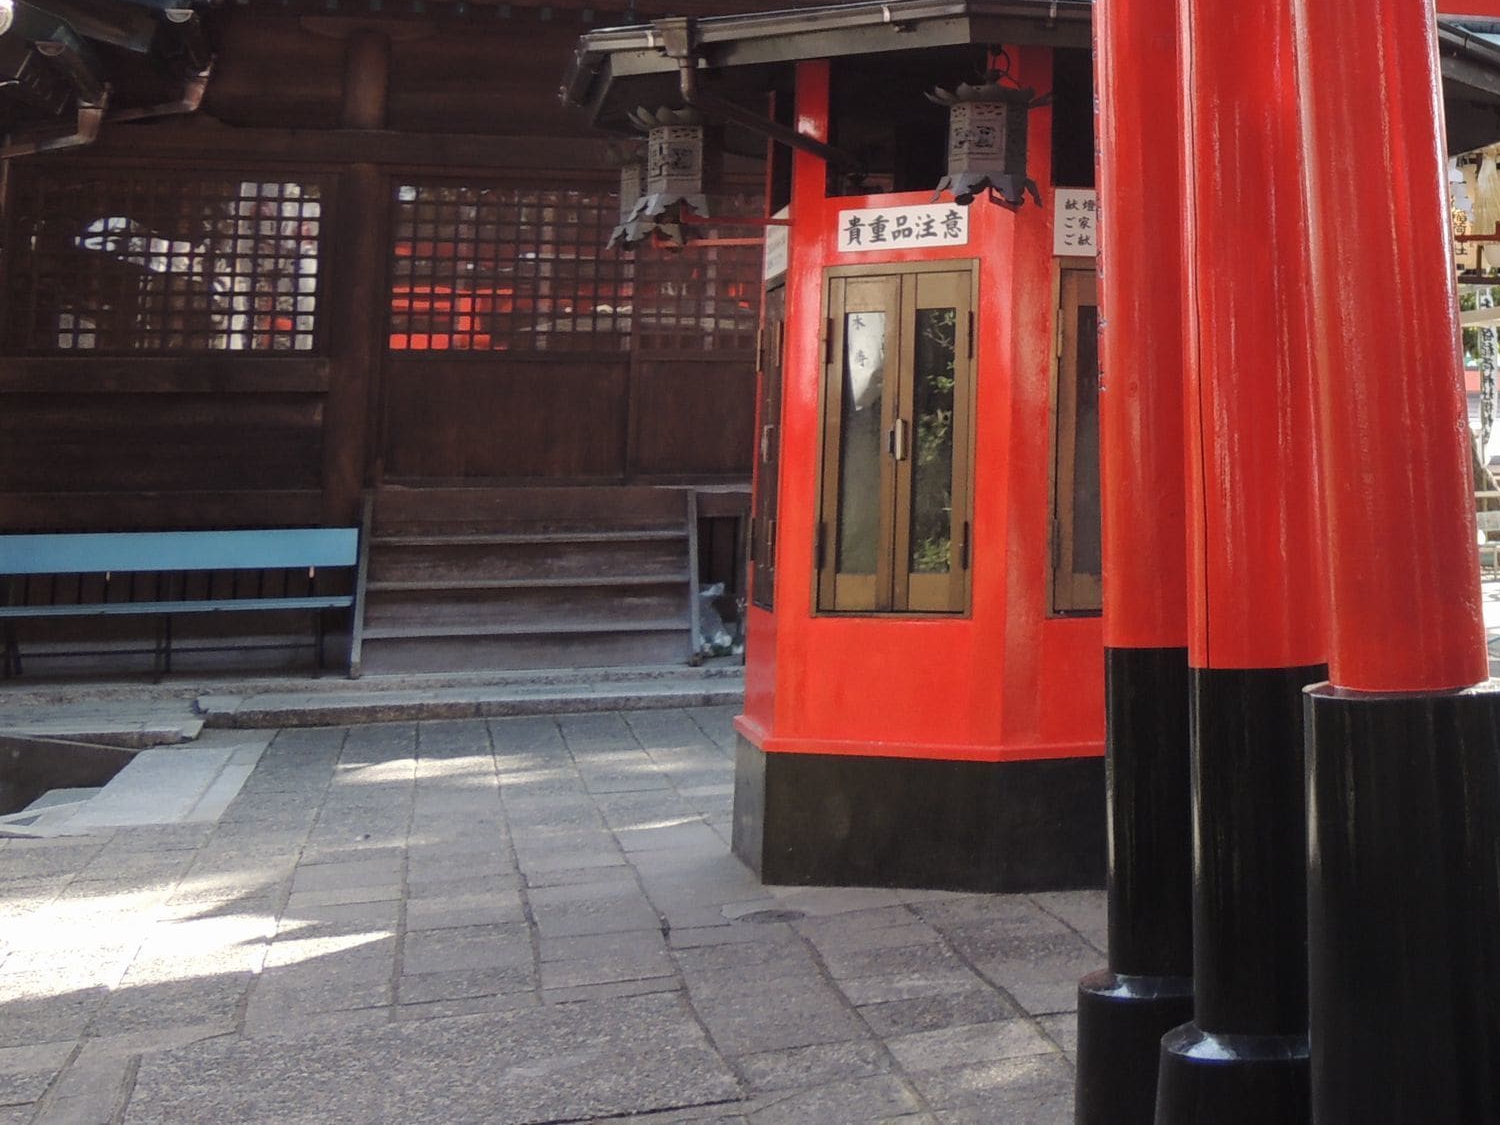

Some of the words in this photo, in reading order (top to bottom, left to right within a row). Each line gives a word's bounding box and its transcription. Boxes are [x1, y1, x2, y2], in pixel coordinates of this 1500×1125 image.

[843, 209, 963, 247] 貴重品注意
